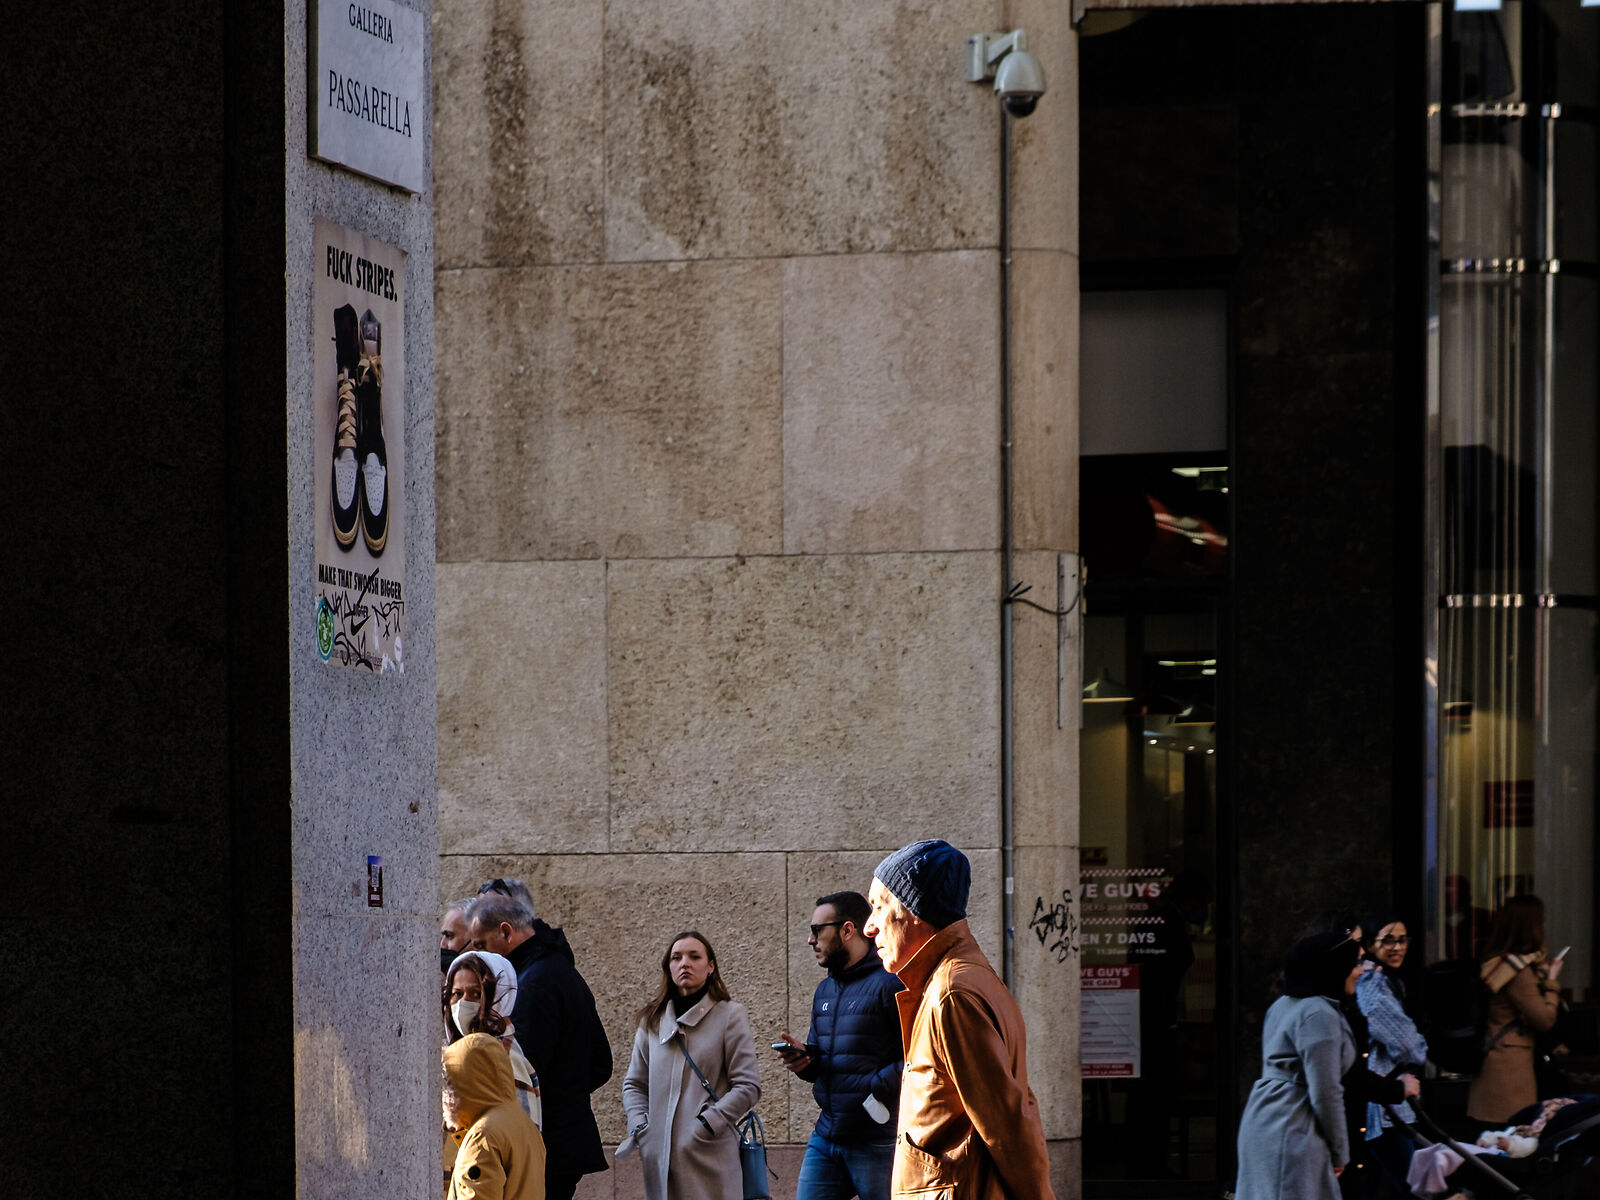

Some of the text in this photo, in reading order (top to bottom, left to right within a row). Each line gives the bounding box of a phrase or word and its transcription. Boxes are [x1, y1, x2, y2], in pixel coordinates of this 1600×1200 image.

[349, 3, 393, 44] GALLERIA
[329, 70, 412, 137] PASSARELLA
[326, 245, 398, 303] FUCK STRIPES.
[318, 563, 337, 585] MAKE
[337, 568, 353, 590] THAT
[380, 578, 402, 600] BIGGER
[1103, 882, 1161, 898] GUYS
[1104, 933, 1113, 945] 7
[1117, 932, 1156, 944] DAYS
[1097, 967, 1130, 977] GUYS
